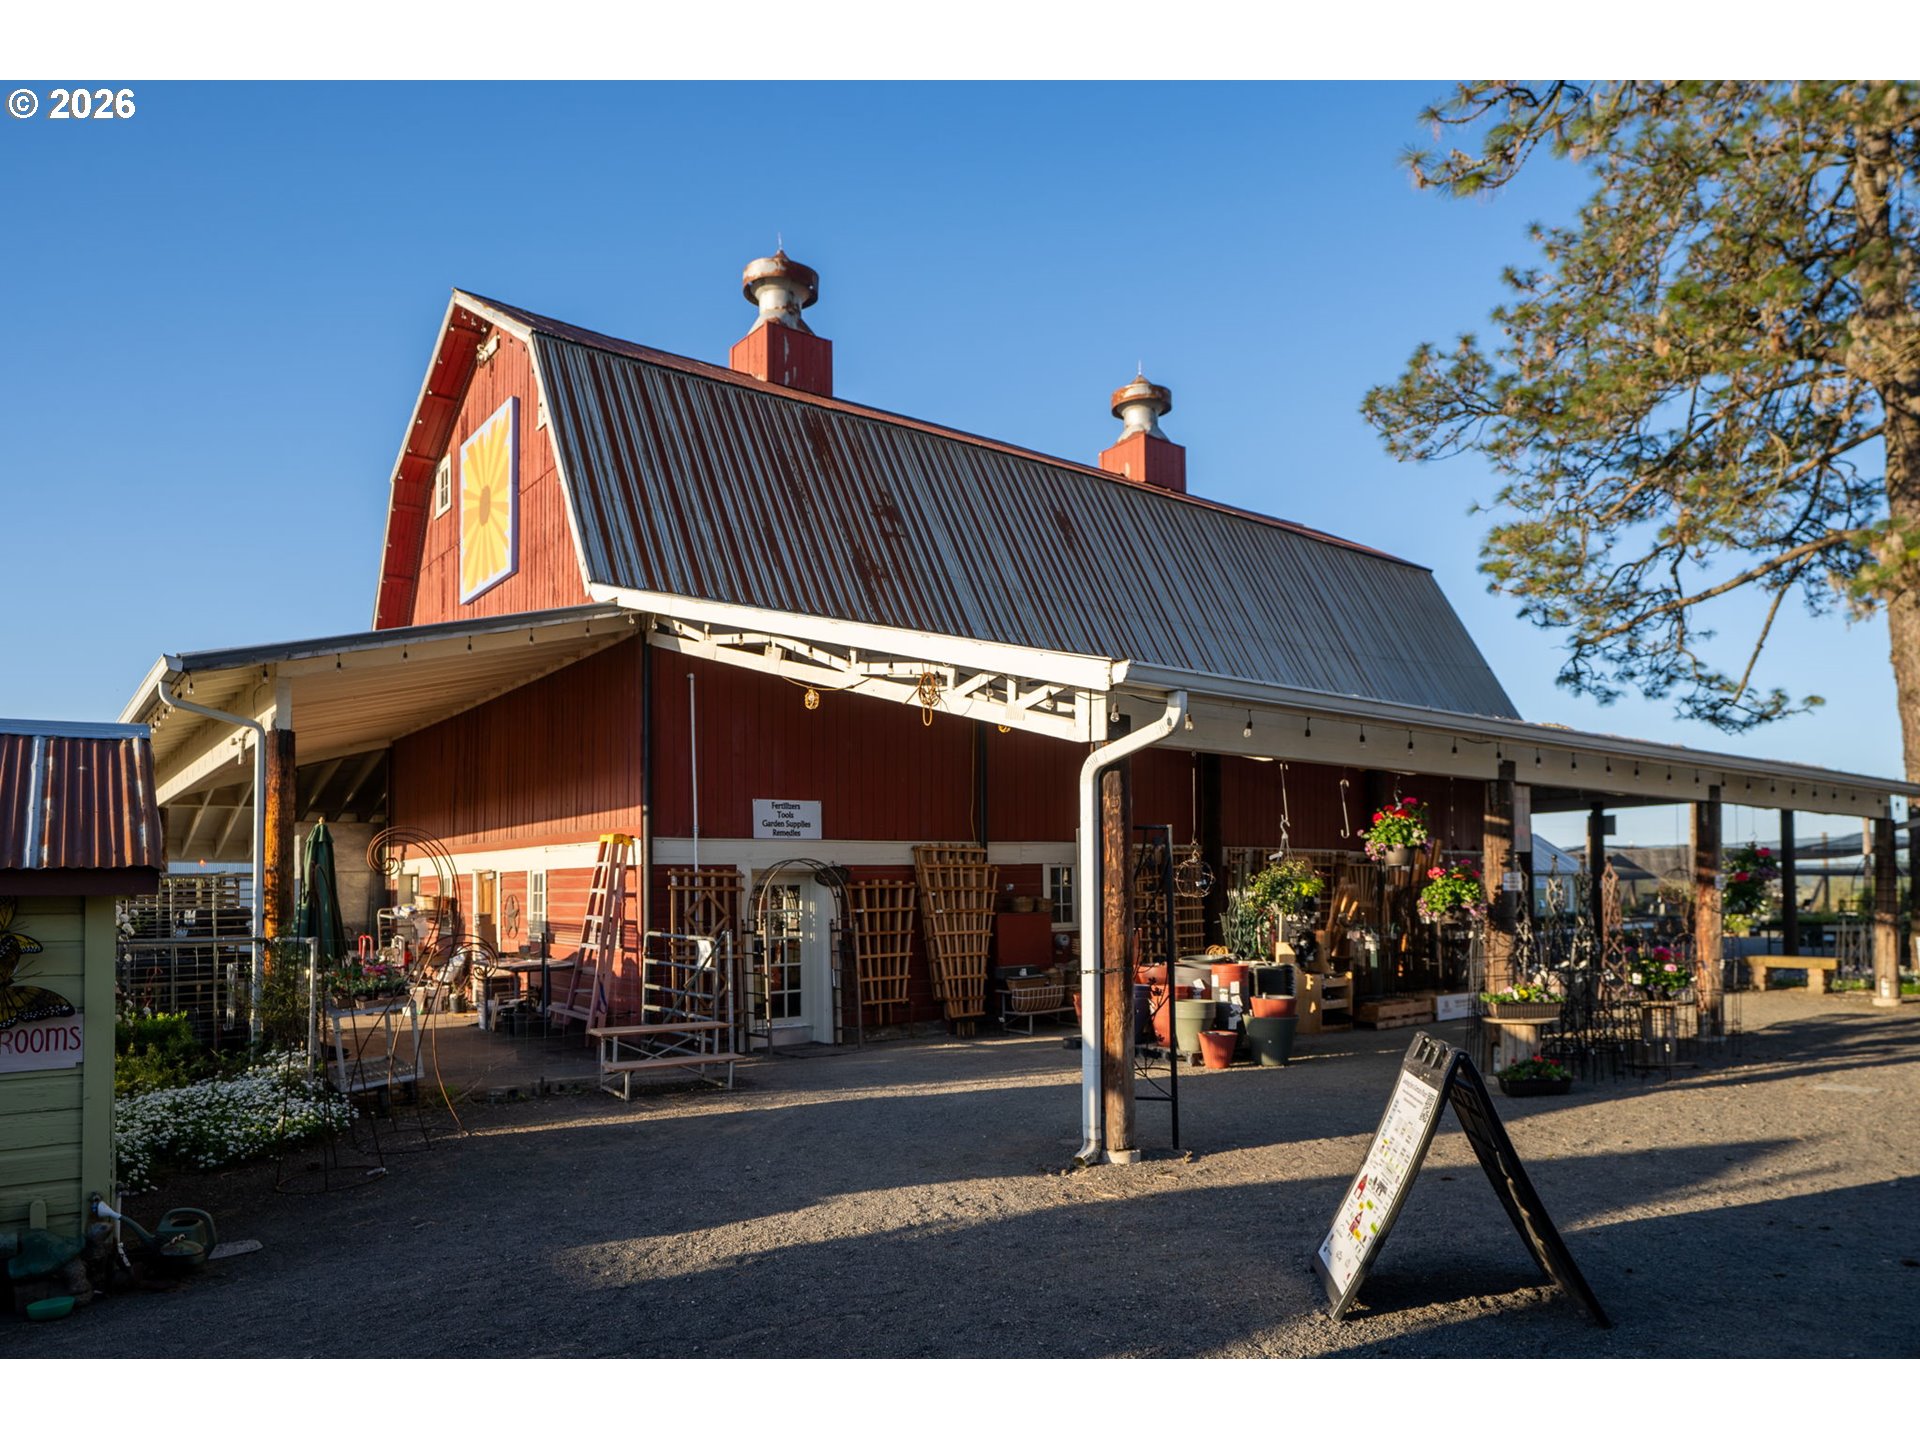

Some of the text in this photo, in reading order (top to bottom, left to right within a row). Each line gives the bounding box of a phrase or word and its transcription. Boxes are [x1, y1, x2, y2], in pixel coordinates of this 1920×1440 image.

[771, 801, 801, 810] Fertilizers
[777, 811, 794, 819] Tools
[762, 819, 811, 829] Garden Supplies
[772, 829, 801, 837] Remedies
